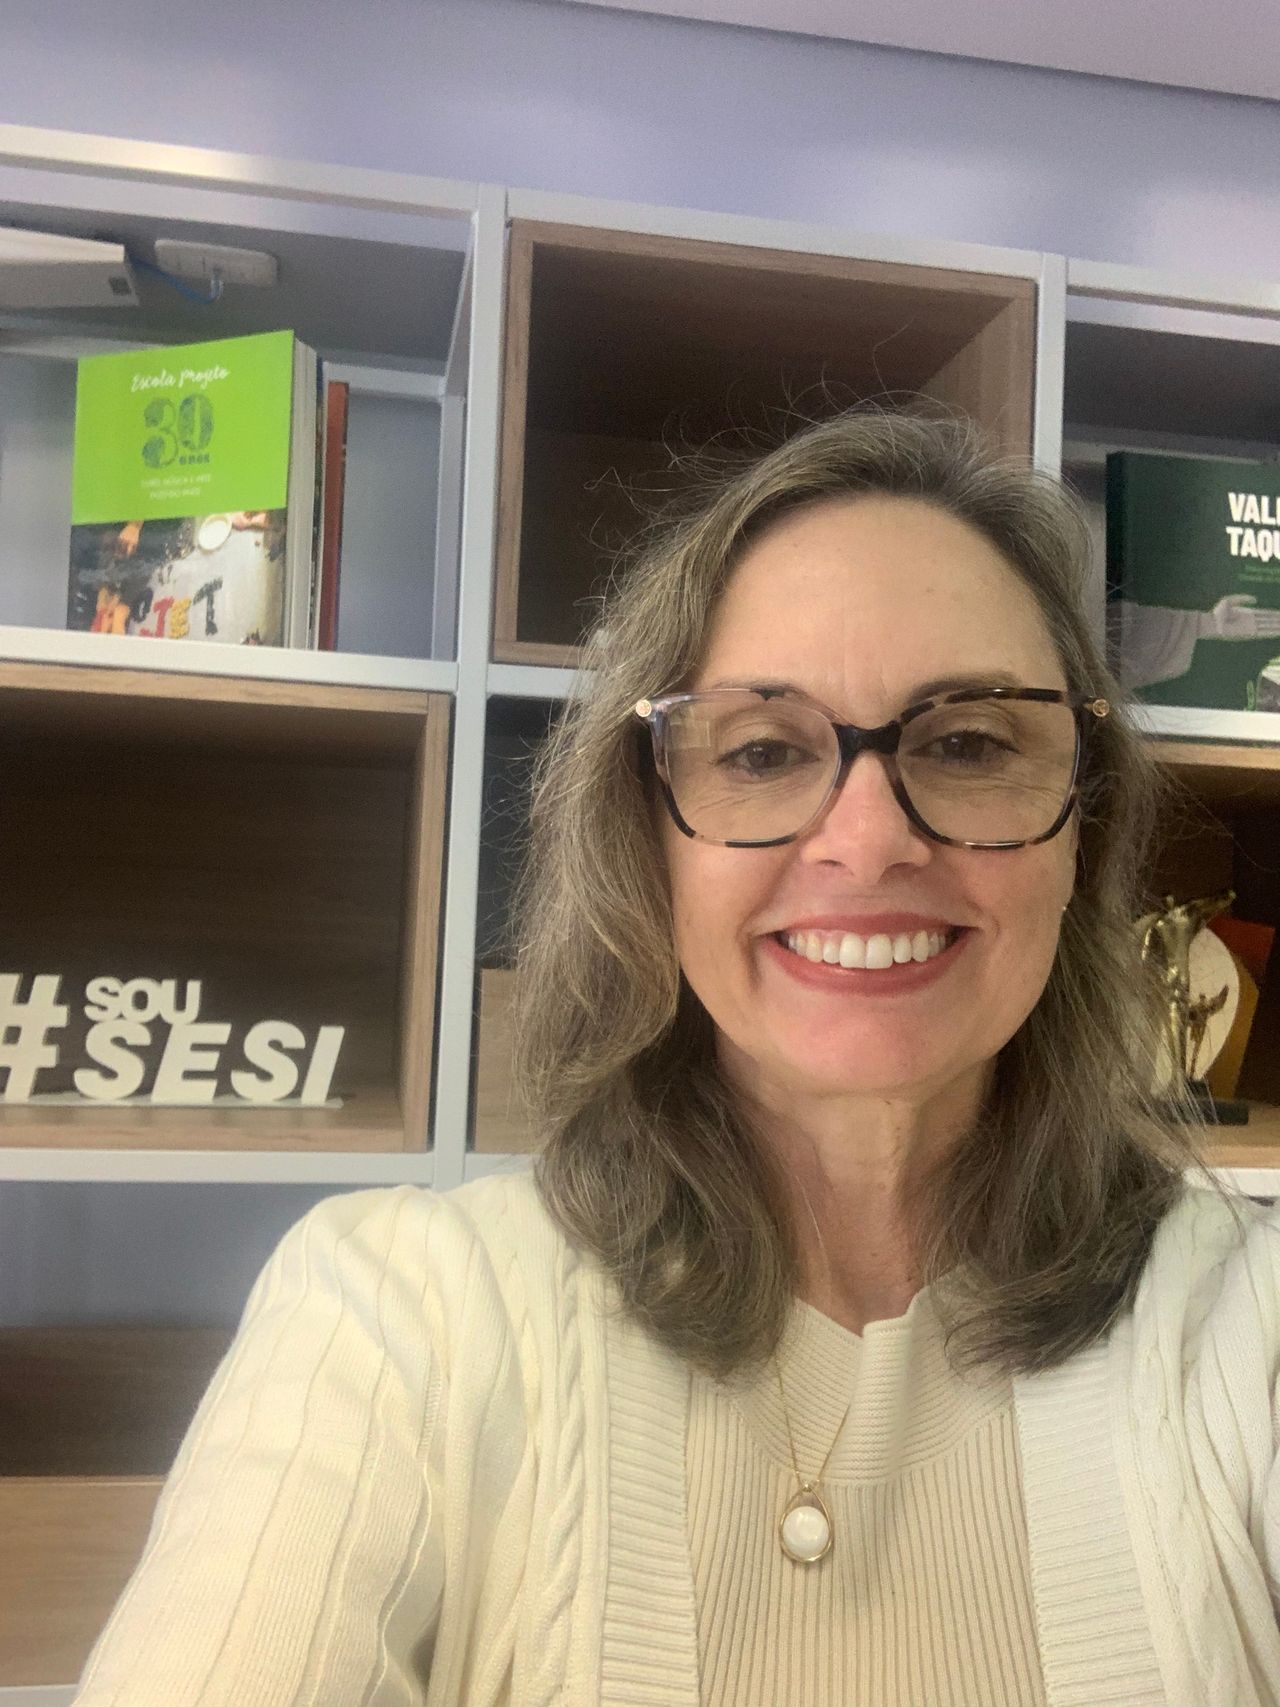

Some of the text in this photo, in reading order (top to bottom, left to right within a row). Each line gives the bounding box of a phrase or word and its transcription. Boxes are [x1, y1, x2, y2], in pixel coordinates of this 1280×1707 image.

[142, 393, 215, 469] 30
[84, 976, 202, 1025] SOU
[73, 1019, 346, 1105] SESI
